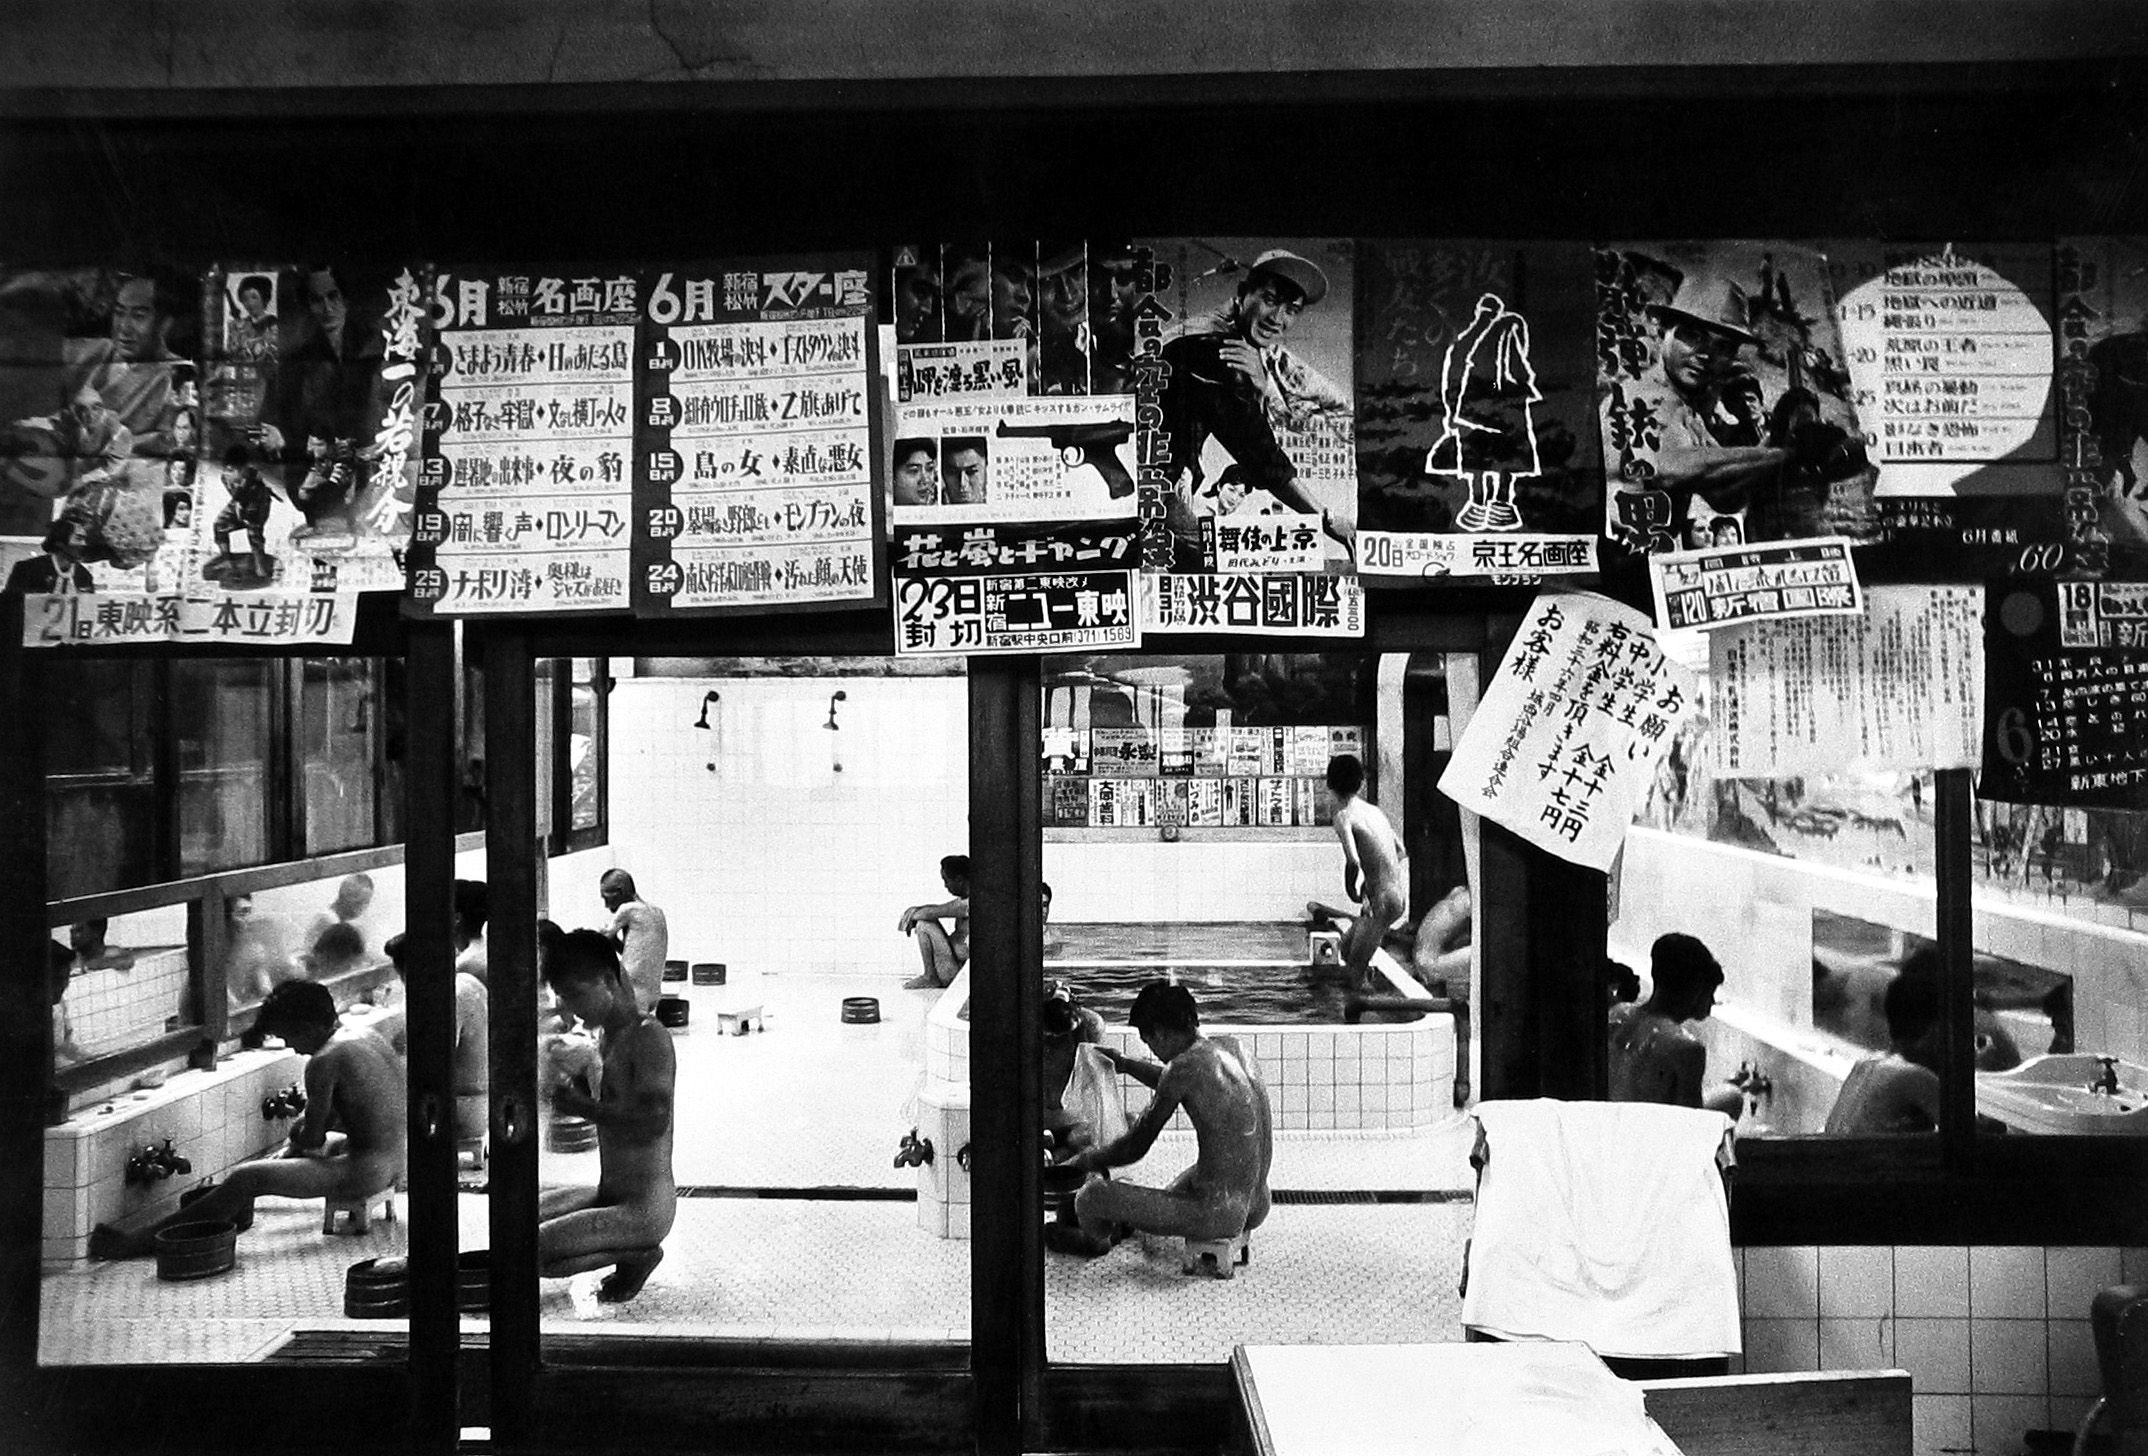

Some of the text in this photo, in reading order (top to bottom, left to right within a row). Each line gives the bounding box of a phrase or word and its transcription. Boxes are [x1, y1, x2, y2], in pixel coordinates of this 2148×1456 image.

[531, 275, 638, 315] 名画座
[648, 269, 872, 325] 6月 スター座
[723, 271, 759, 291] 新宿
[724, 291, 759, 311] 松竹
[656, 341, 665, 357] 1
[452, 399, 536, 433] 格子なき牢獄
[651, 397, 671, 414] 8
[549, 451, 624, 485] 夜の豹
[650, 453, 674, 469] 15
[693, 442, 864, 481] 島の女 素直な悪女
[451, 509, 627, 543] 闇に響く声 ロンリーマン
[650, 509, 678, 525] 20
[784, 498, 867, 533] モンブランの夜
[899, 526, 1137, 570] 花と嵐とギャング
[1472, 539, 1591, 568] 京王名画座
[451, 568, 533, 601] ナポリ湾
[648, 565, 679, 581] 24
[900, 576, 982, 623] 23日
[985, 593, 1007, 632] 新宿
[1007, 587, 1128, 631] ニュー東映
[1680, 589, 1708, 625] 120
[905, 618, 983, 648] 封切
[1509, 603, 1566, 684] お客様
[1627, 684, 1685, 761] お願い
[1539, 742, 1596, 830] 金十七円
[1557, 754, 1616, 844] 金十三円
